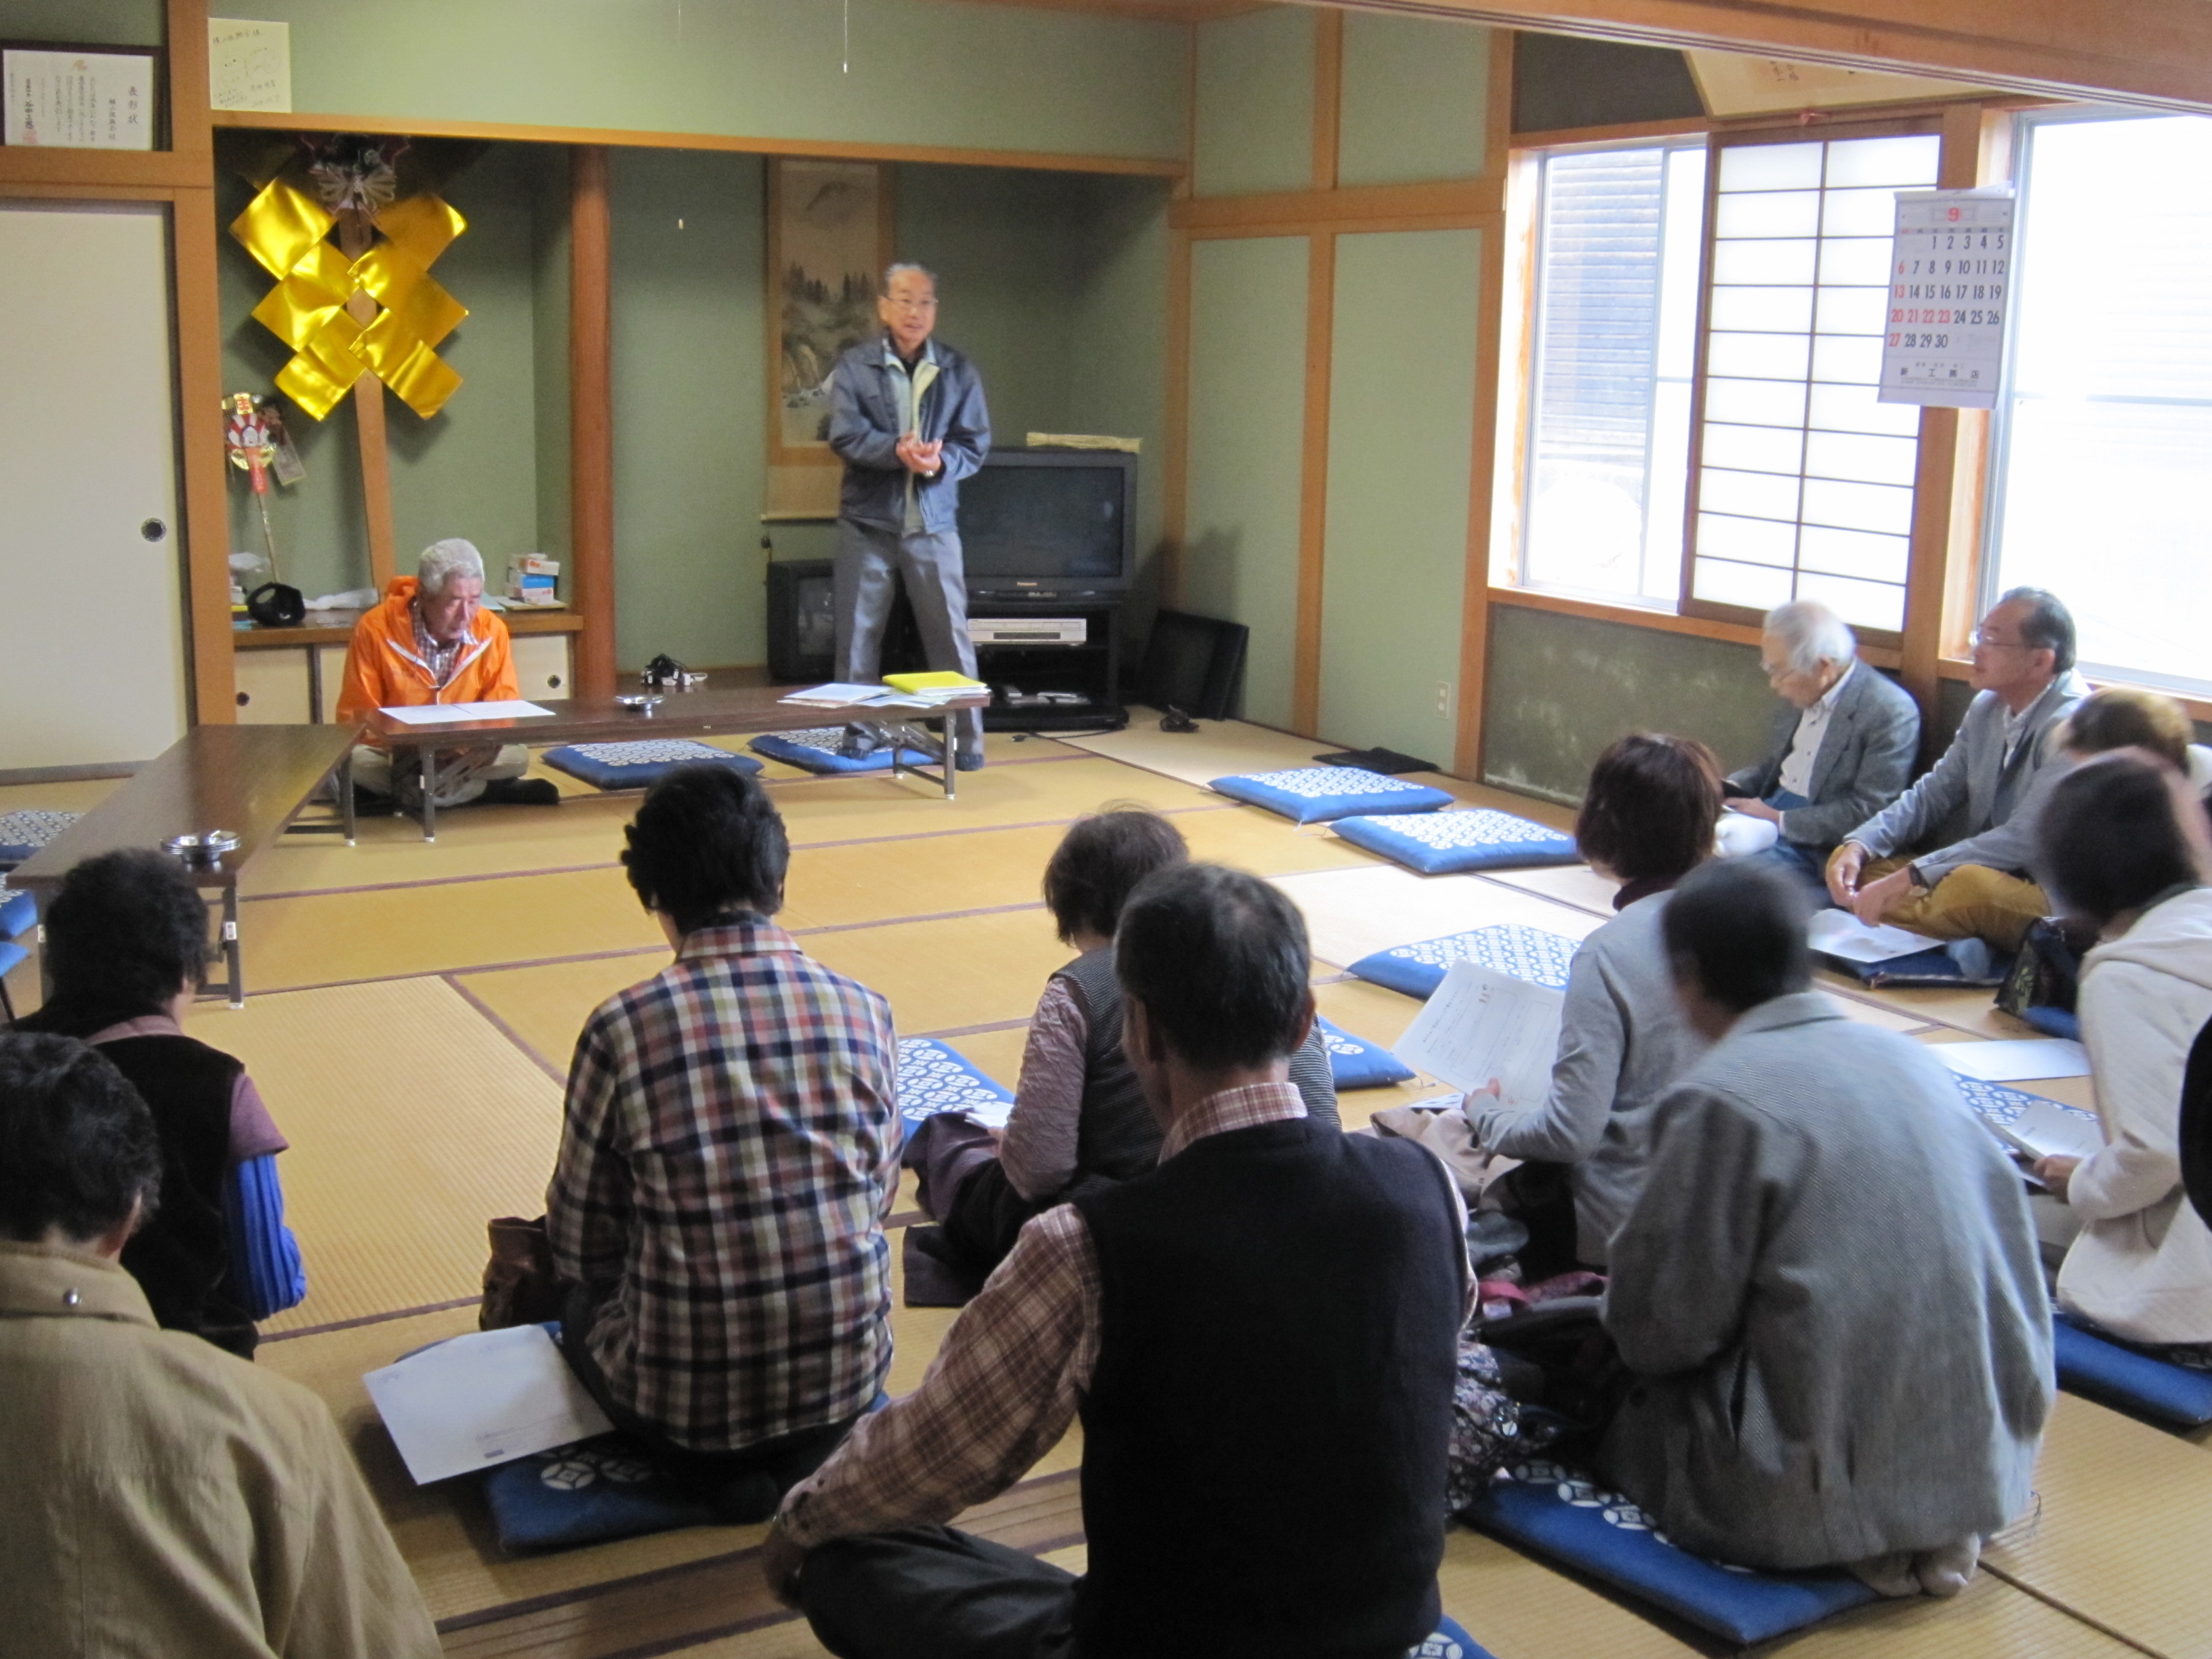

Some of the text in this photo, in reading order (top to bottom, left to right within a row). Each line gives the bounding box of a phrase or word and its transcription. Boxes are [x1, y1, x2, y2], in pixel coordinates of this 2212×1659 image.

[127, 86, 139, 124] 表彰状
[1948, 207, 1961, 222] 9
[1933, 235, 2003, 249] 1 2 3 4 5
[1899, 260, 2004, 274] 6 7 8 9 10 11 12
[1894, 285, 2001, 299] 13 14 15 16 17 18 19
[1891, 309, 1999, 325] 20 21 22 23 24 25 26
[1889, 333, 1948, 348] 27 28 29 30
